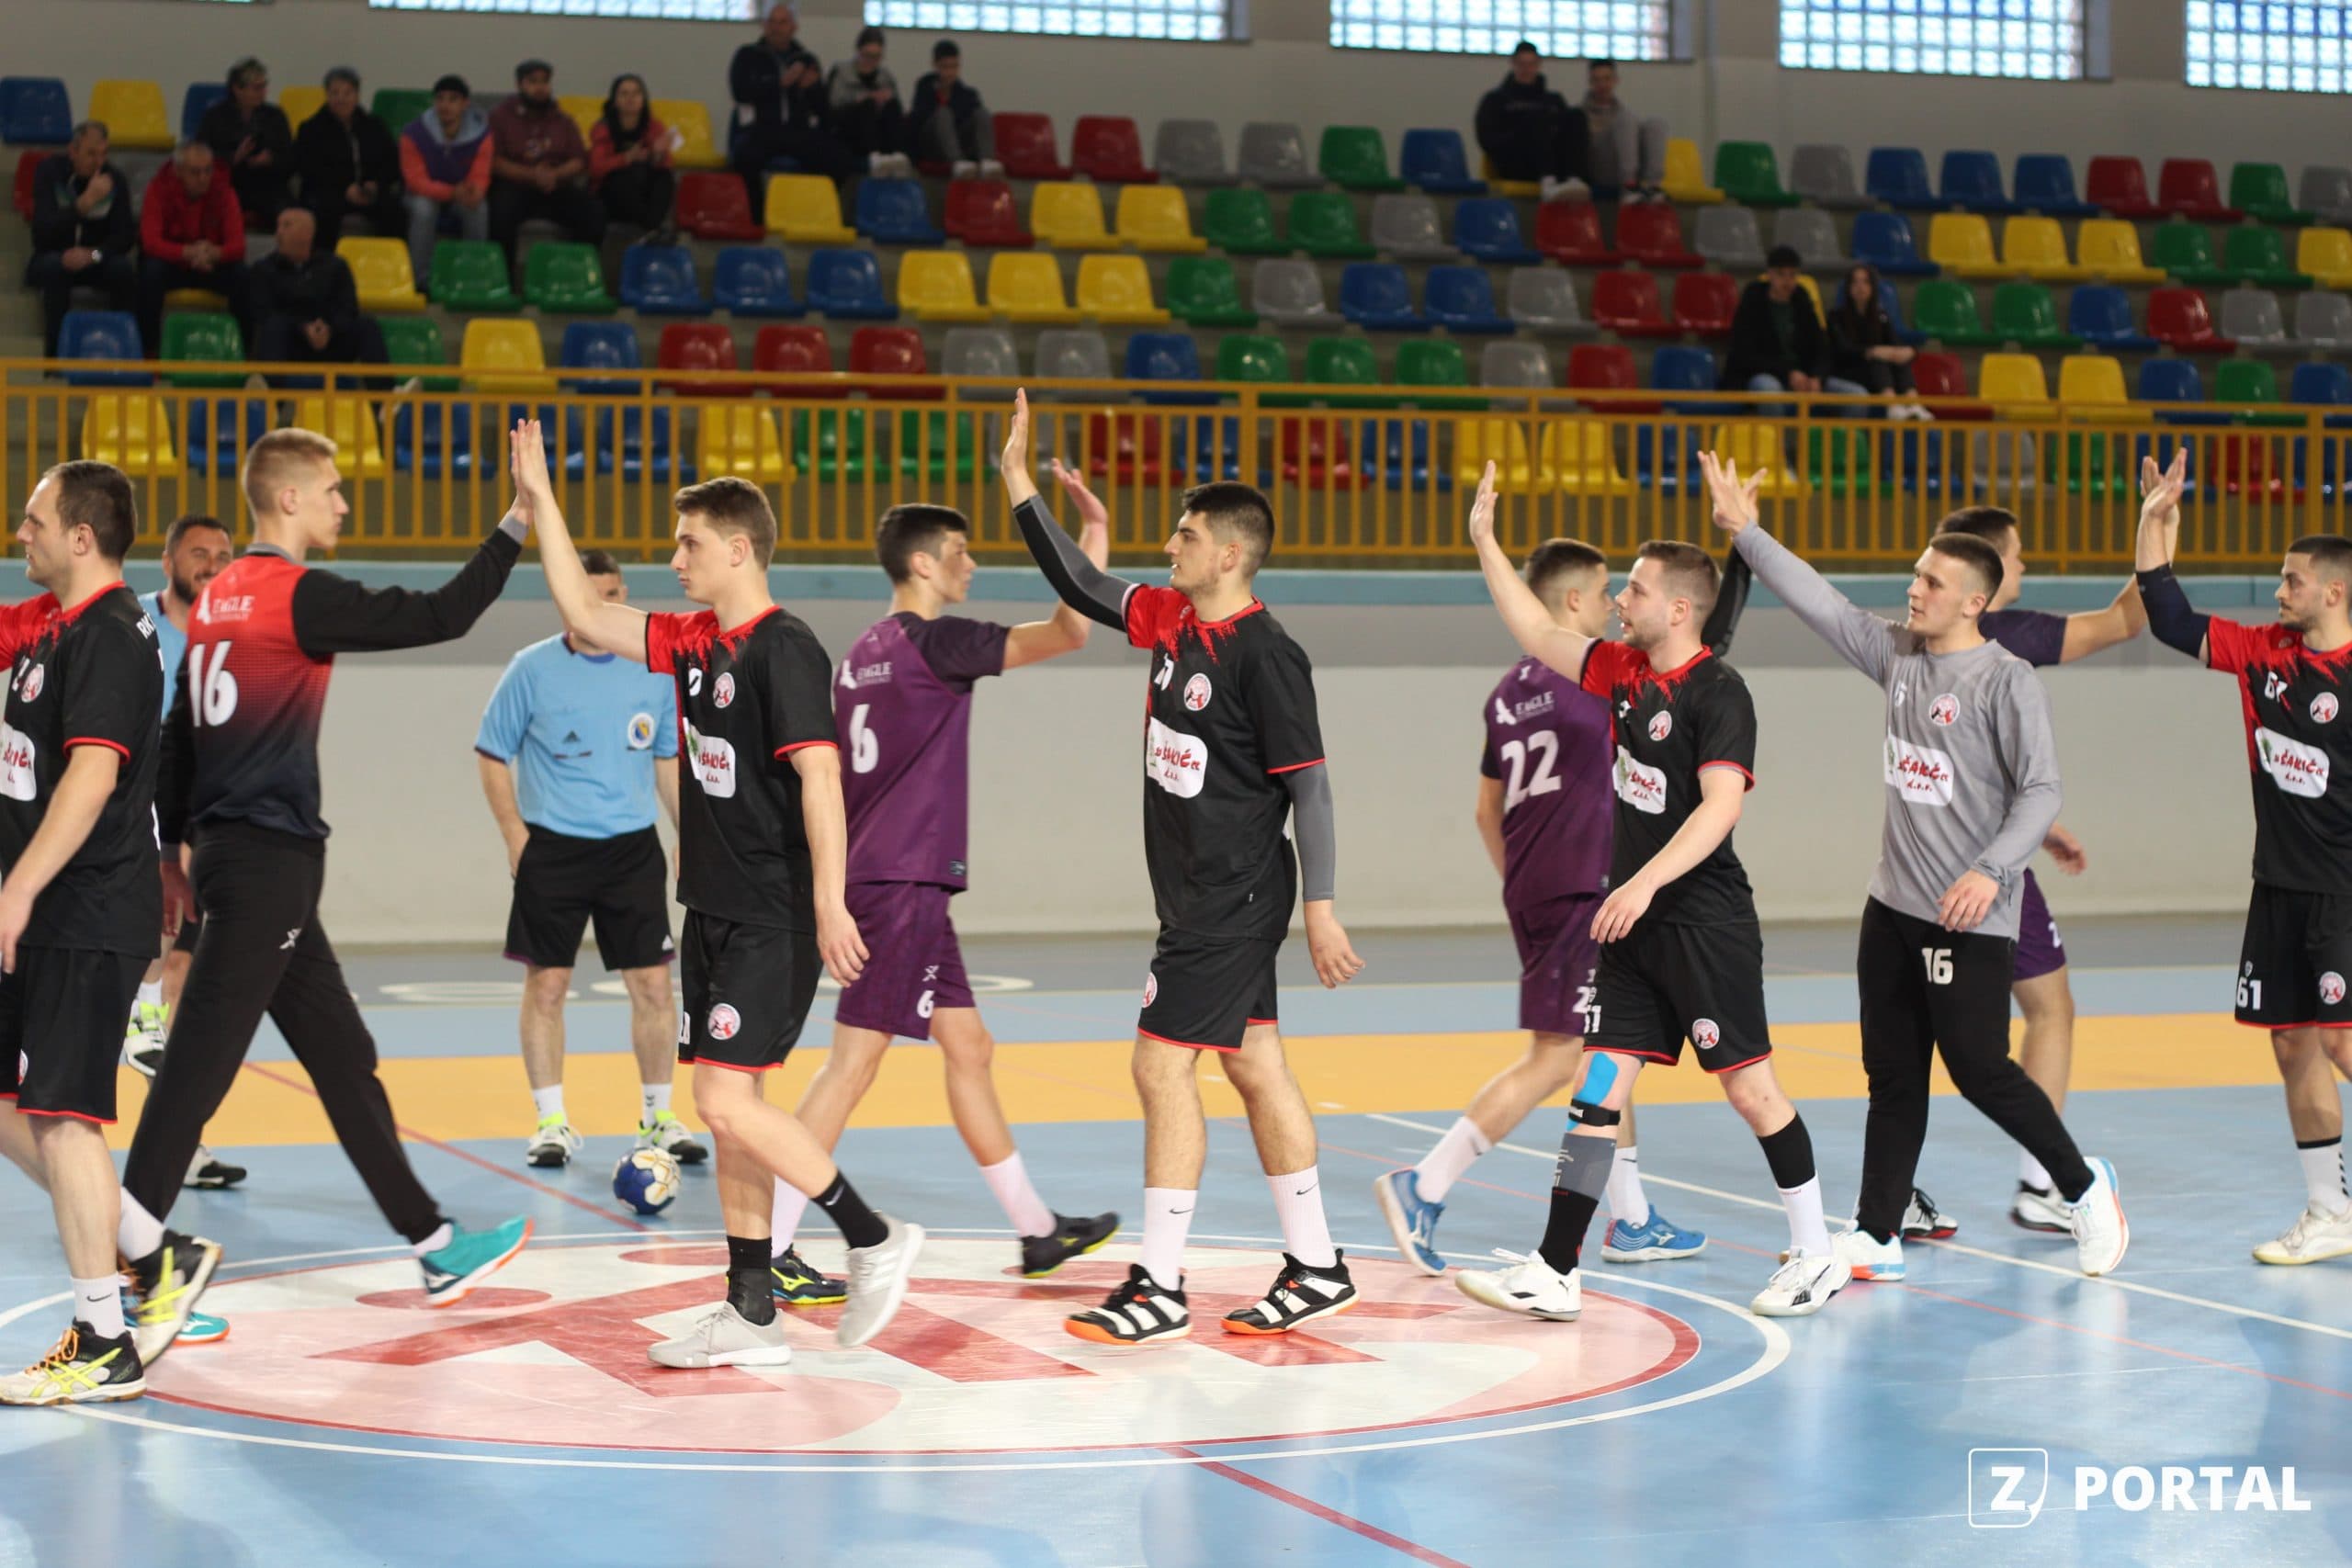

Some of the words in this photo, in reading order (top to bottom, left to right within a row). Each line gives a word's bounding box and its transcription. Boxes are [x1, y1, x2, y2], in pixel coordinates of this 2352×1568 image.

[188, 640, 238, 728] 16
[849, 704, 879, 773] 6
[1500, 730, 1562, 814] 22
[1921, 947, 1953, 985] 16
[917, 989, 934, 1019] 6
[2236, 976, 2261, 1010] 61
